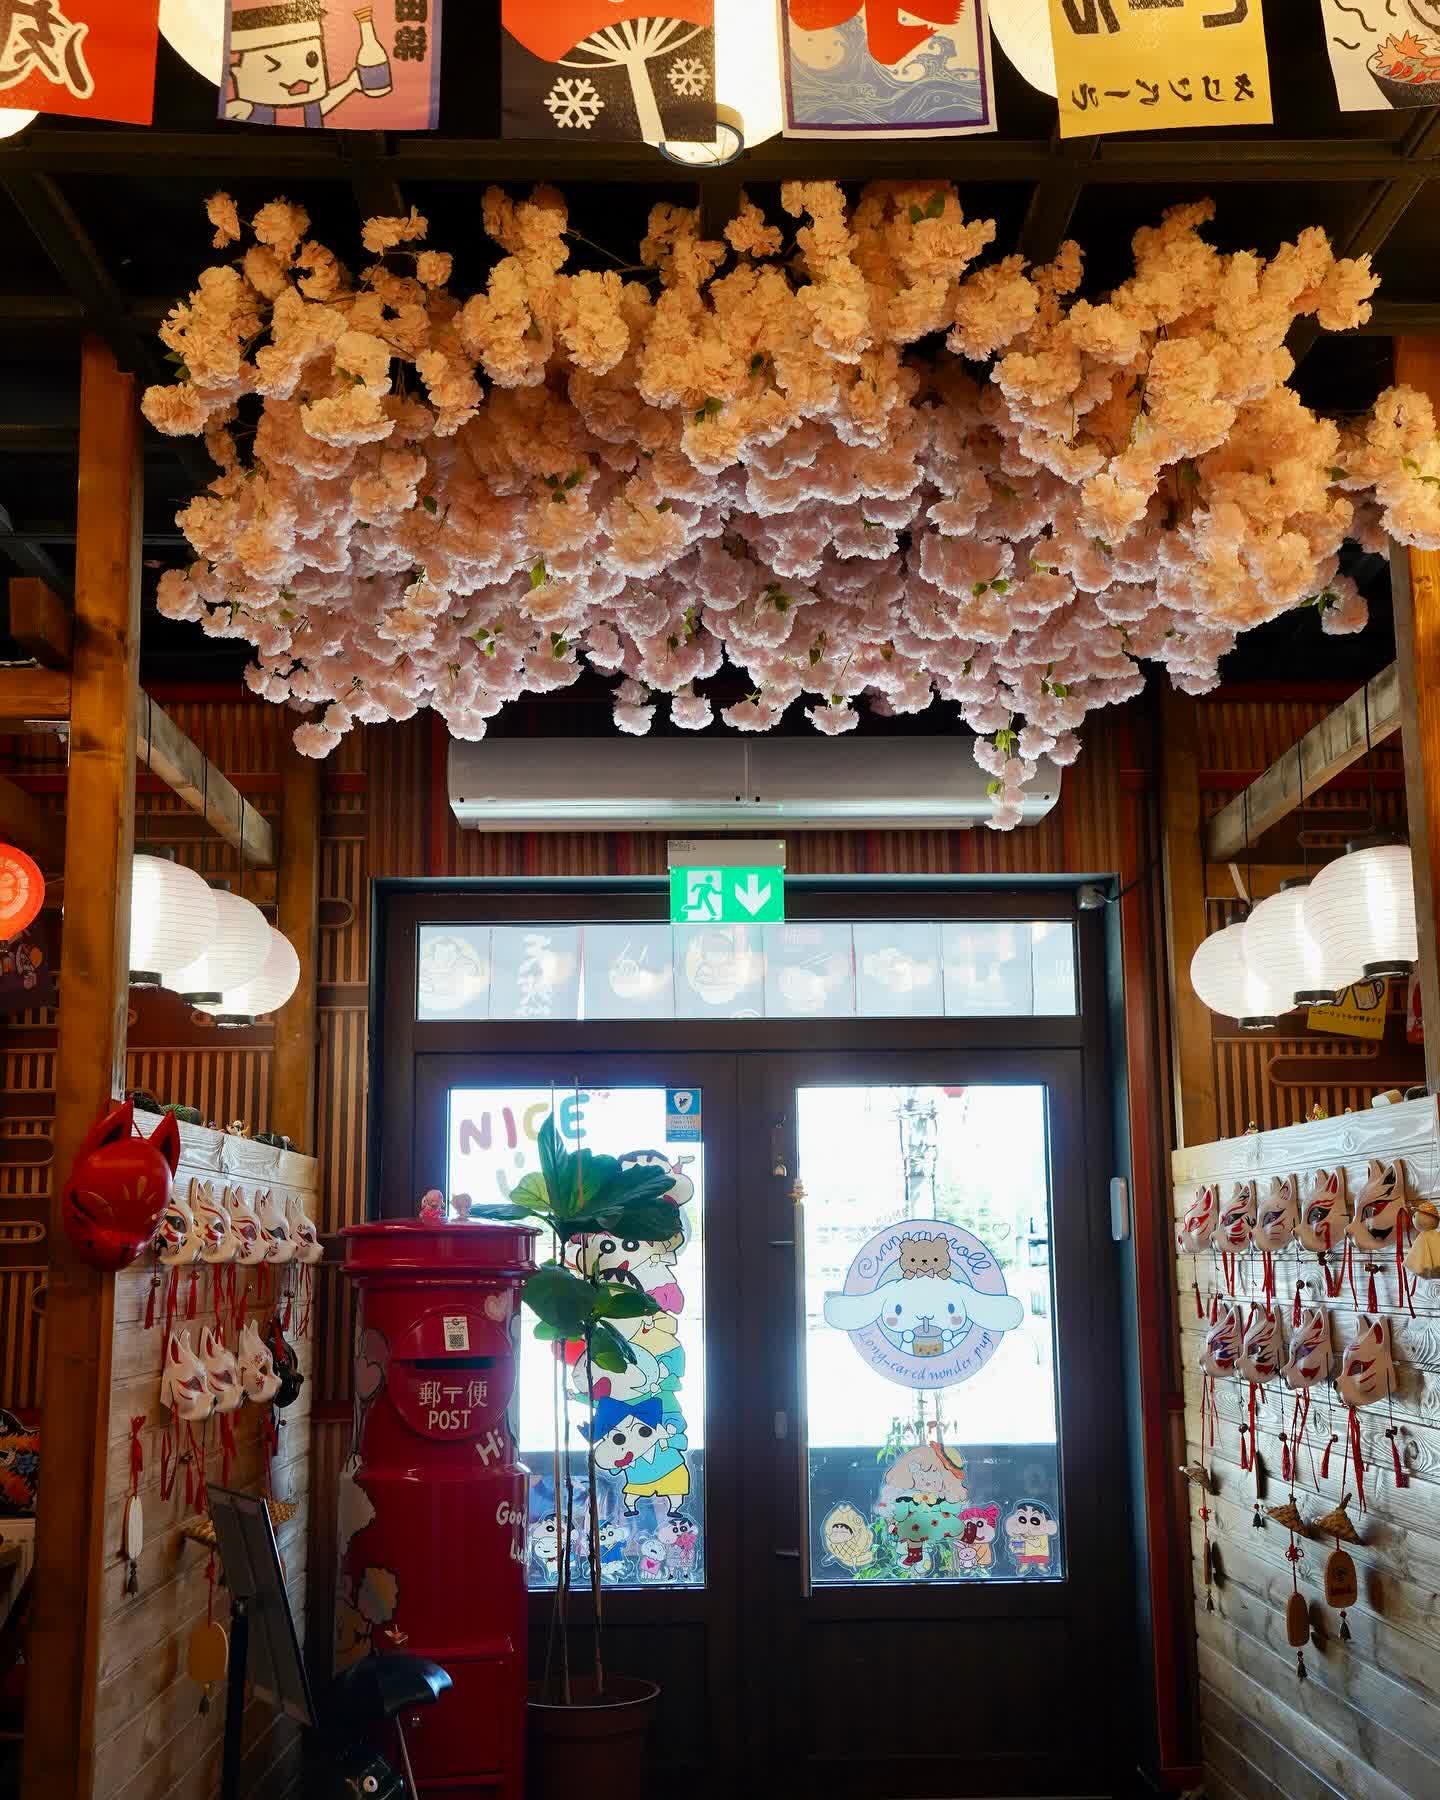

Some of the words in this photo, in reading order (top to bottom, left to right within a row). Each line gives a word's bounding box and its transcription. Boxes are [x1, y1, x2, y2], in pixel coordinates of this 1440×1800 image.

[459, 1093, 591, 1155] NICE
[428, 1409, 472, 1431] POST
[474, 1428, 505, 1467] Hi
[495, 1500, 528, 1529] Good
